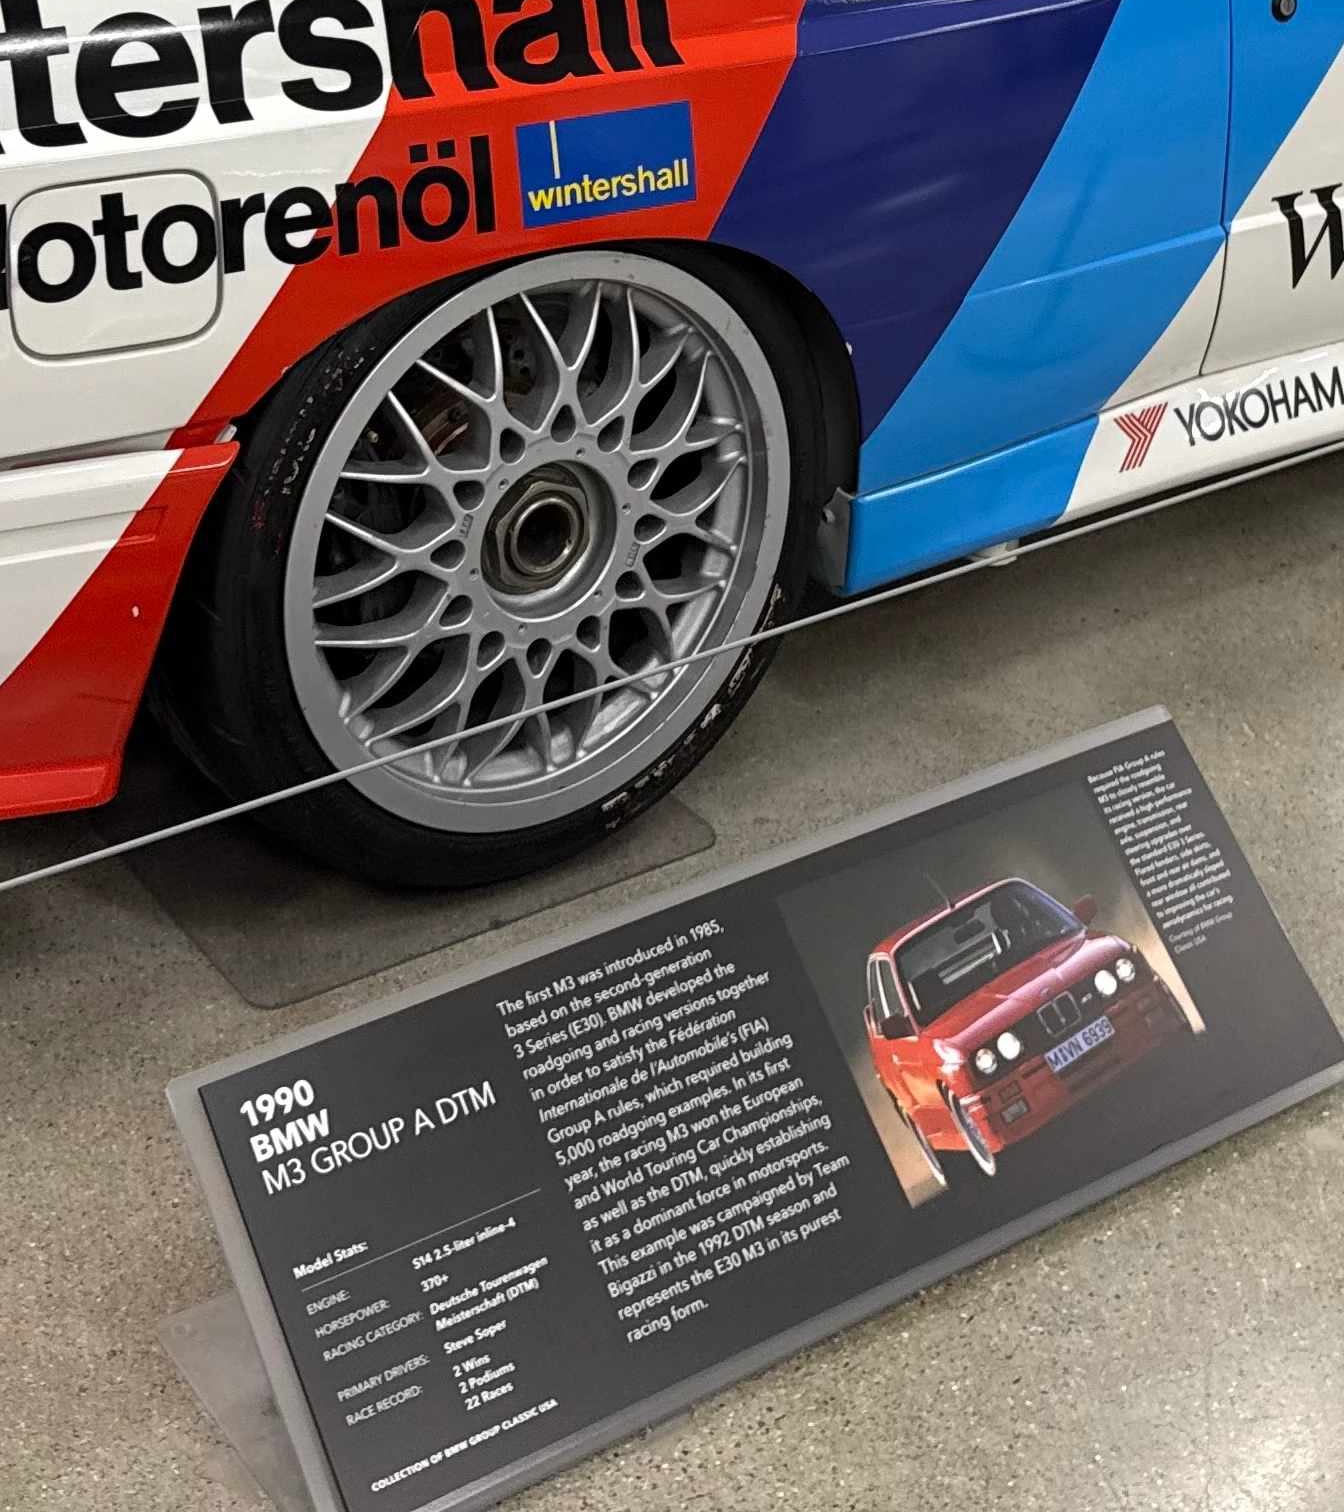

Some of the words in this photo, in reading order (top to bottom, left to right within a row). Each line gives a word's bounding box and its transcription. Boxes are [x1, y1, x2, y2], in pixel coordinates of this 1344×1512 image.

[527, 157, 690, 212] wintershall
[494, 998, 525, 1016] The
[524, 985, 554, 1006] first
[551, 974, 577, 996] M3
[576, 967, 604, 986] was
[602, 935, 675, 976] introduced
[672, 933, 689, 948] in
[688, 917, 725, 942] 1985,
[503, 1008, 549, 1038] based
[549, 1004, 569, 1021] on
[568, 995, 593, 1013] the
[593, 947, 713, 1004] second-generation
[512, 1042, 525, 1059] 3
[524, 1028, 569, 1055] Series
[567, 1011, 608, 1039] (E30).
[605, 994, 644, 1023] BMW
[644, 966, 714, 1006] developed
[712, 962, 736, 979] the
[521, 1043, 594, 1080] roadgoing
[593, 1027, 621, 1052] and
[620, 1014, 664, 1041] racing
[662, 993, 717, 1023] versions
[714, 970, 770, 1002] together
[528, 1086, 546, 1102] in
[545, 1070, 584, 1095] order
[583, 1064, 602, 1079] to
[601, 1043, 644, 1073] satisfy
[643, 1036, 669, 1055] the
[667, 1008, 737, 1045] Fédération
[537, 1075, 629, 1124] Internationale
[629, 1067, 649, 1085] de
[736, 1015, 770, 1042] (FIA)
[239, 1078, 315, 1127] 1990
[546, 1117, 592, 1144] Group
[593, 1108, 608, 1126] A
[605, 1096, 645, 1121] rules,
[643, 1076, 684, 1104] which
[683, 1050, 741, 1087] required
[737, 1033, 794, 1063] building
[554, 1137, 596, 1166] 5,000
[596, 1110, 668, 1149] roadgoing
[666, 1084, 733, 1119] examples.
[730, 1075, 748, 1091] In
[745, 1068, 765, 1085] its
[762, 1056, 792, 1077] first
[248, 1107, 330, 1163] BMW
[260, 1156, 307, 1195] M3
[309, 1116, 405, 1174] GROUP
[414, 1107, 436, 1136] A
[434, 1079, 497, 1125] DTM
[563, 1165, 599, 1193] year,
[597, 1154, 623, 1174] the
[623, 1135, 668, 1163] racing
[664, 1121, 690, 1144] M3
[689, 1113, 720, 1134] won
[718, 1102, 743, 1121] the
[740, 1076, 804, 1112] European
[572, 1184, 602, 1210] and
[598, 1165, 645, 1197] World
[642, 1147, 698, 1178] Touring
[695, 1135, 721, 1155] Car
[721, 1094, 823, 1144] Championships,
[581, 1215, 600, 1232] as
[598, 1198, 629, 1224] well
[629, 1194, 647, 1211] as
[645, 1184, 671, 1203] the
[669, 1165, 709, 1193] DTM,
[707, 1145, 754, 1178] quickly
[755, 1113, 832, 1155] establishing
[291, 1251, 334, 1280] Model
[332, 1240, 369, 1263] Stats:
[411, 1251, 434, 1270] S14
[432, 1235, 476, 1261] 2.5-liter
[474, 1215, 517, 1243] inline-4
[305, 1288, 351, 1316] ENGINE:
[419, 1273, 450, 1293] 370+
[428, 1286, 480, 1316] Deutsche
[478, 1255, 549, 1293] Tourenwagen
[434, 1290, 507, 1332] Meisterschaft
[505, 1276, 540, 1301] (DTM)
[313, 1298, 391, 1339] HORSEPOWER:
[322, 1334, 366, 1362] RACING
[364, 1309, 425, 1343] CATEGORY:
[442, 1334, 475, 1355] Steve
[473, 1318, 507, 1341] Soper
[336, 1372, 383, 1402] PRIMARY
[382, 1353, 431, 1382] DRIVERS:
[451, 1363, 464, 1378] 2
[460, 1353, 492, 1373] Wins
[457, 1380, 469, 1394] 2
[466, 1361, 516, 1390] Podiums
[344, 1403, 377, 1426] RACE
[374, 1384, 424, 1413] RECORD:
[463, 1393, 482, 1411] 22
[479, 1381, 515, 1403] Races
[370, 1457, 431, 1492] COLLECTION
[428, 1450, 444, 1465] OF
[442, 1439, 469, 1458] BMW
[467, 1423, 501, 1446] GROUP
[500, 1405, 540, 1431] CLASSIC
[537, 1397, 559, 1413] USA
